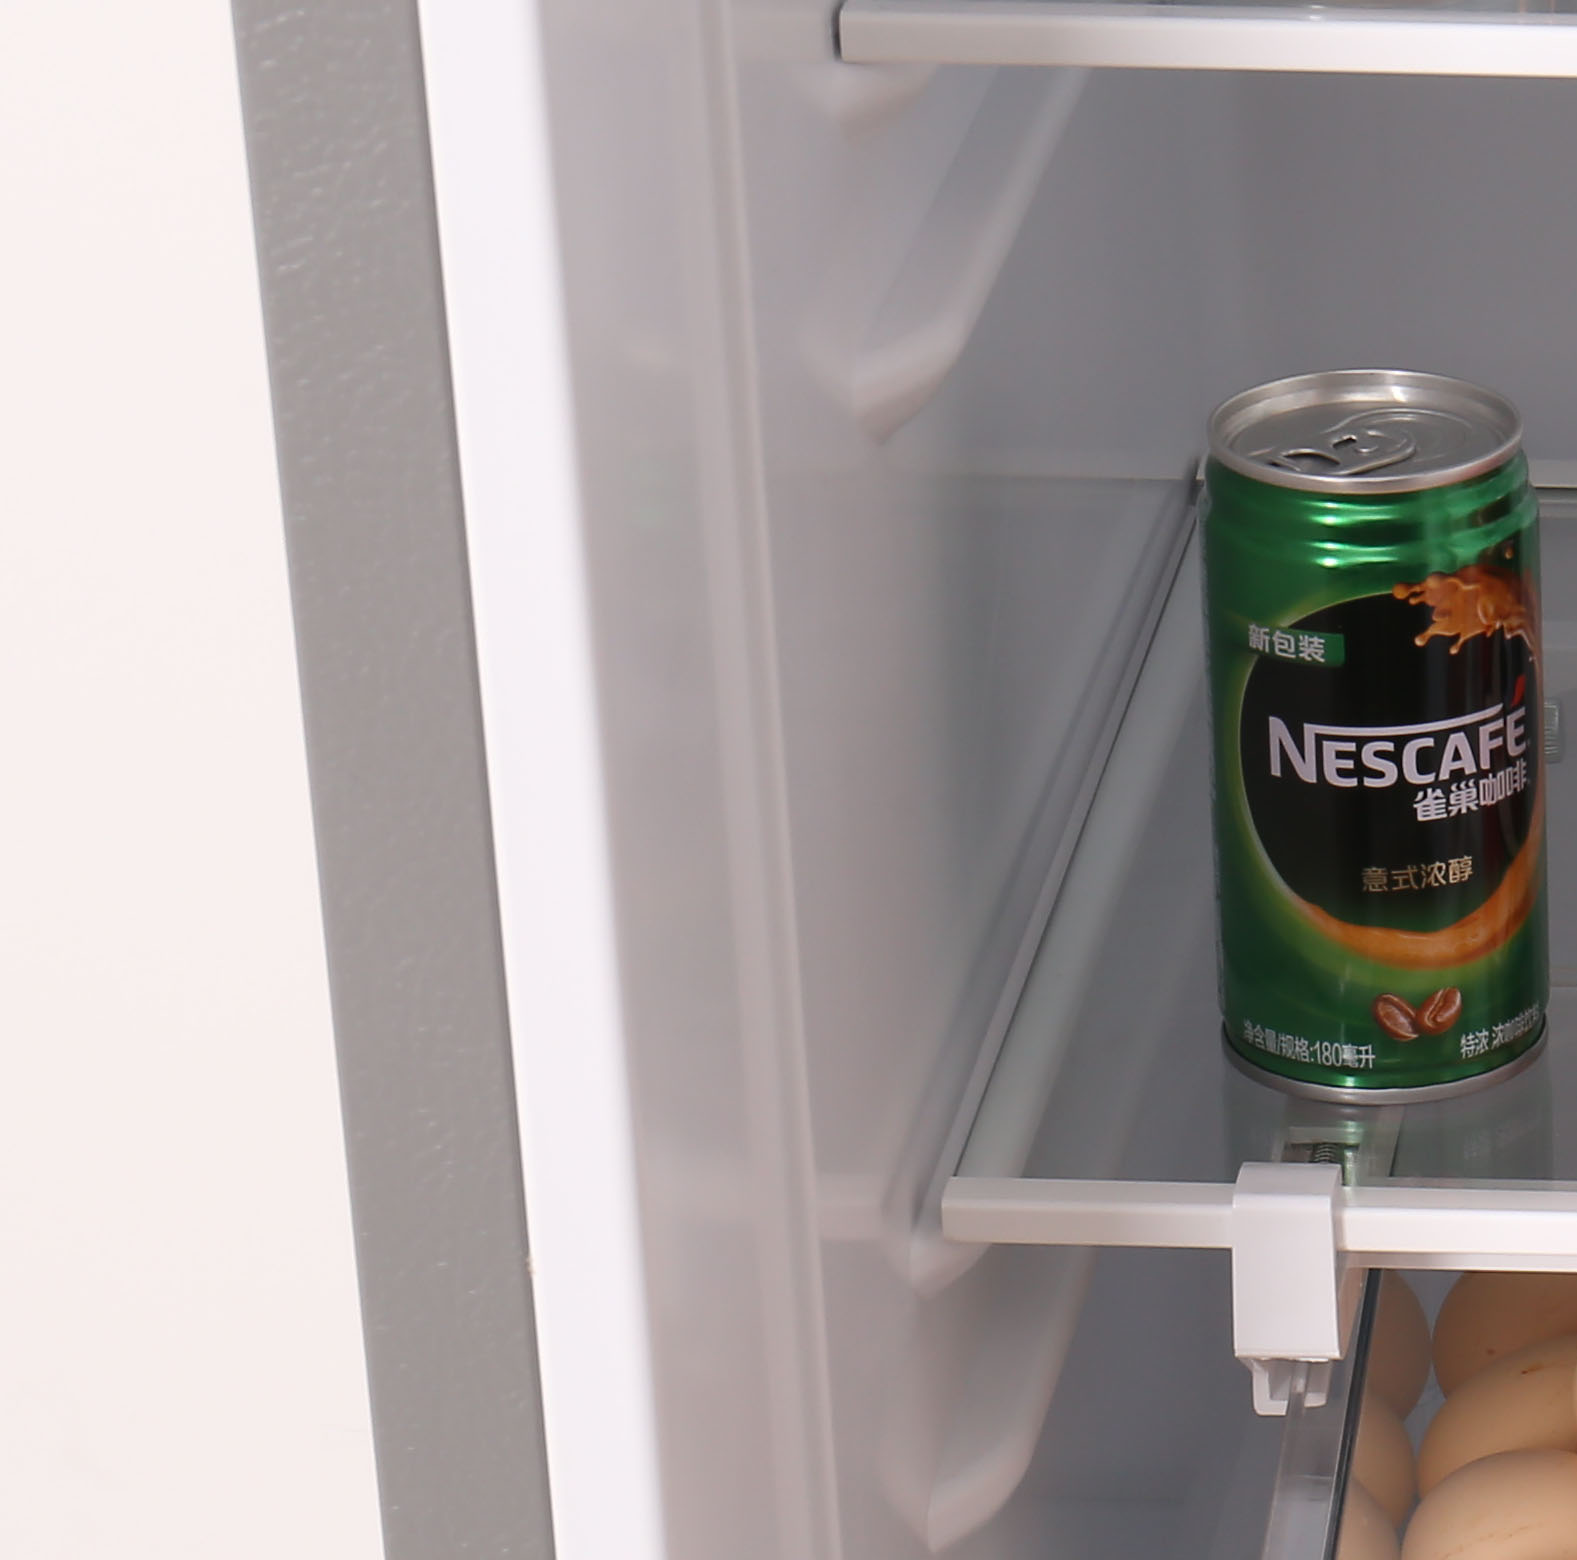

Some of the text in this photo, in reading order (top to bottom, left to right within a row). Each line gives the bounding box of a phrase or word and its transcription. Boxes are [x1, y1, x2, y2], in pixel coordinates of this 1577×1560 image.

[1249, 624, 1325, 662] 新包装
[1413, 758, 1527, 822] 雀巢咖啡
[1361, 855, 1473, 892] 意式浓醇
